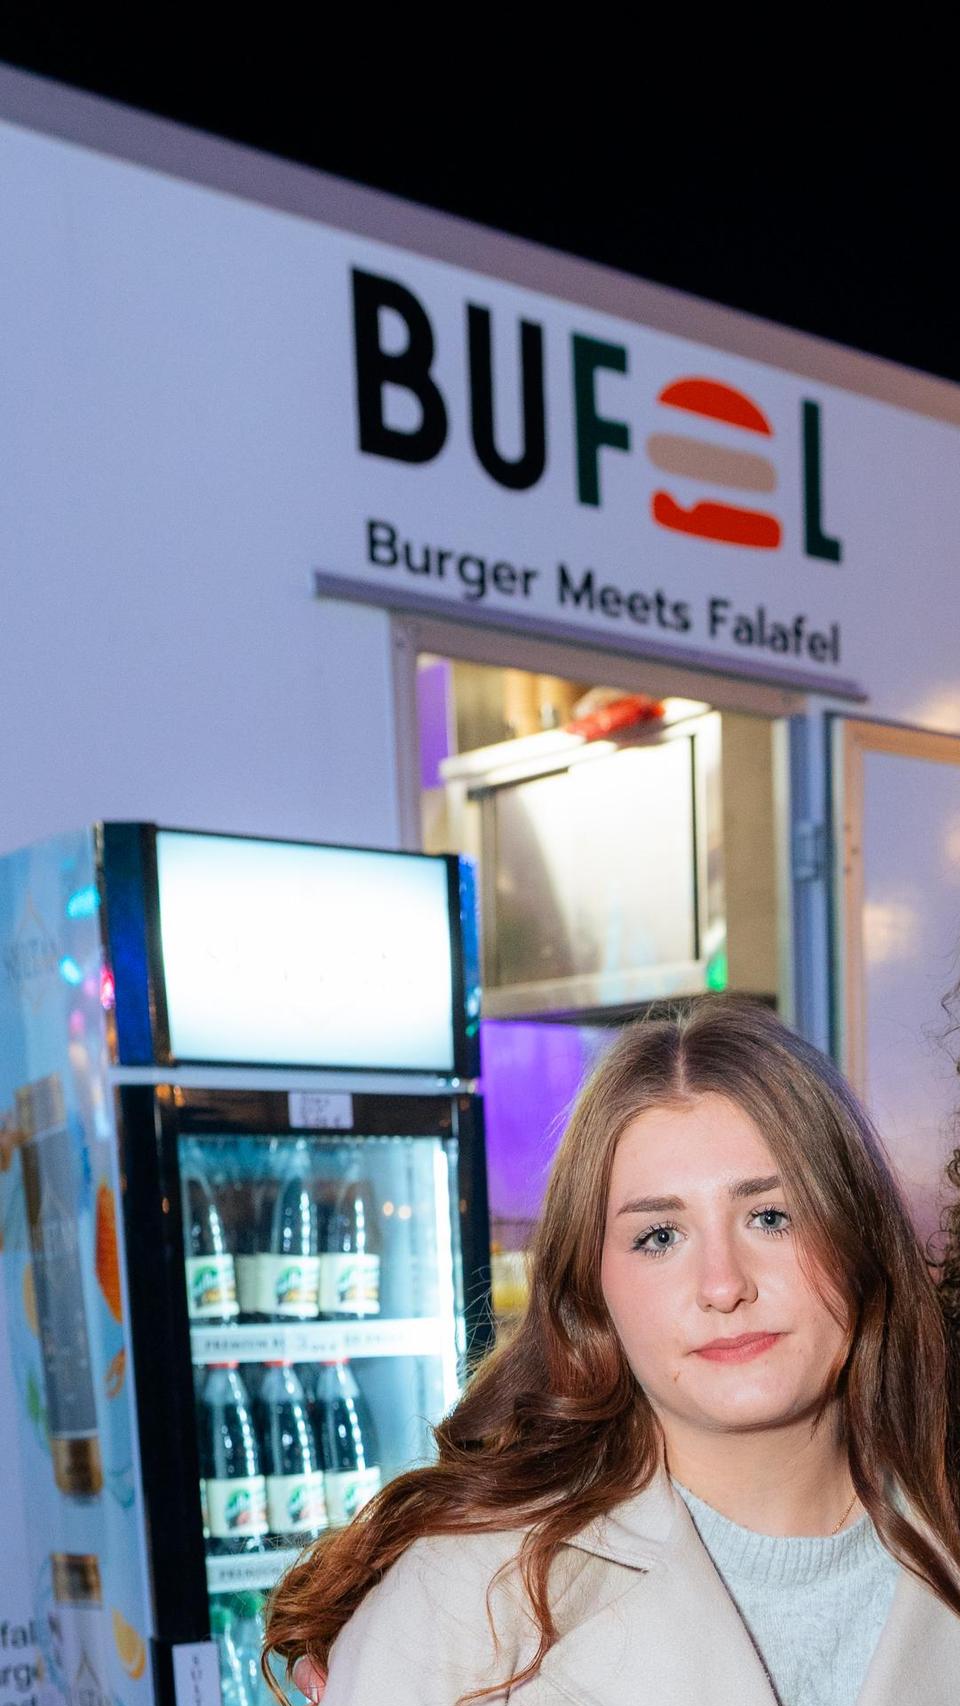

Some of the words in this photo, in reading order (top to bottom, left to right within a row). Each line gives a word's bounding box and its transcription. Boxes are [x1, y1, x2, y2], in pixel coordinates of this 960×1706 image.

[366, 518, 538, 602] Burger
[556, 562, 692, 633] Meets
[707, 596, 841, 665] Falafel
